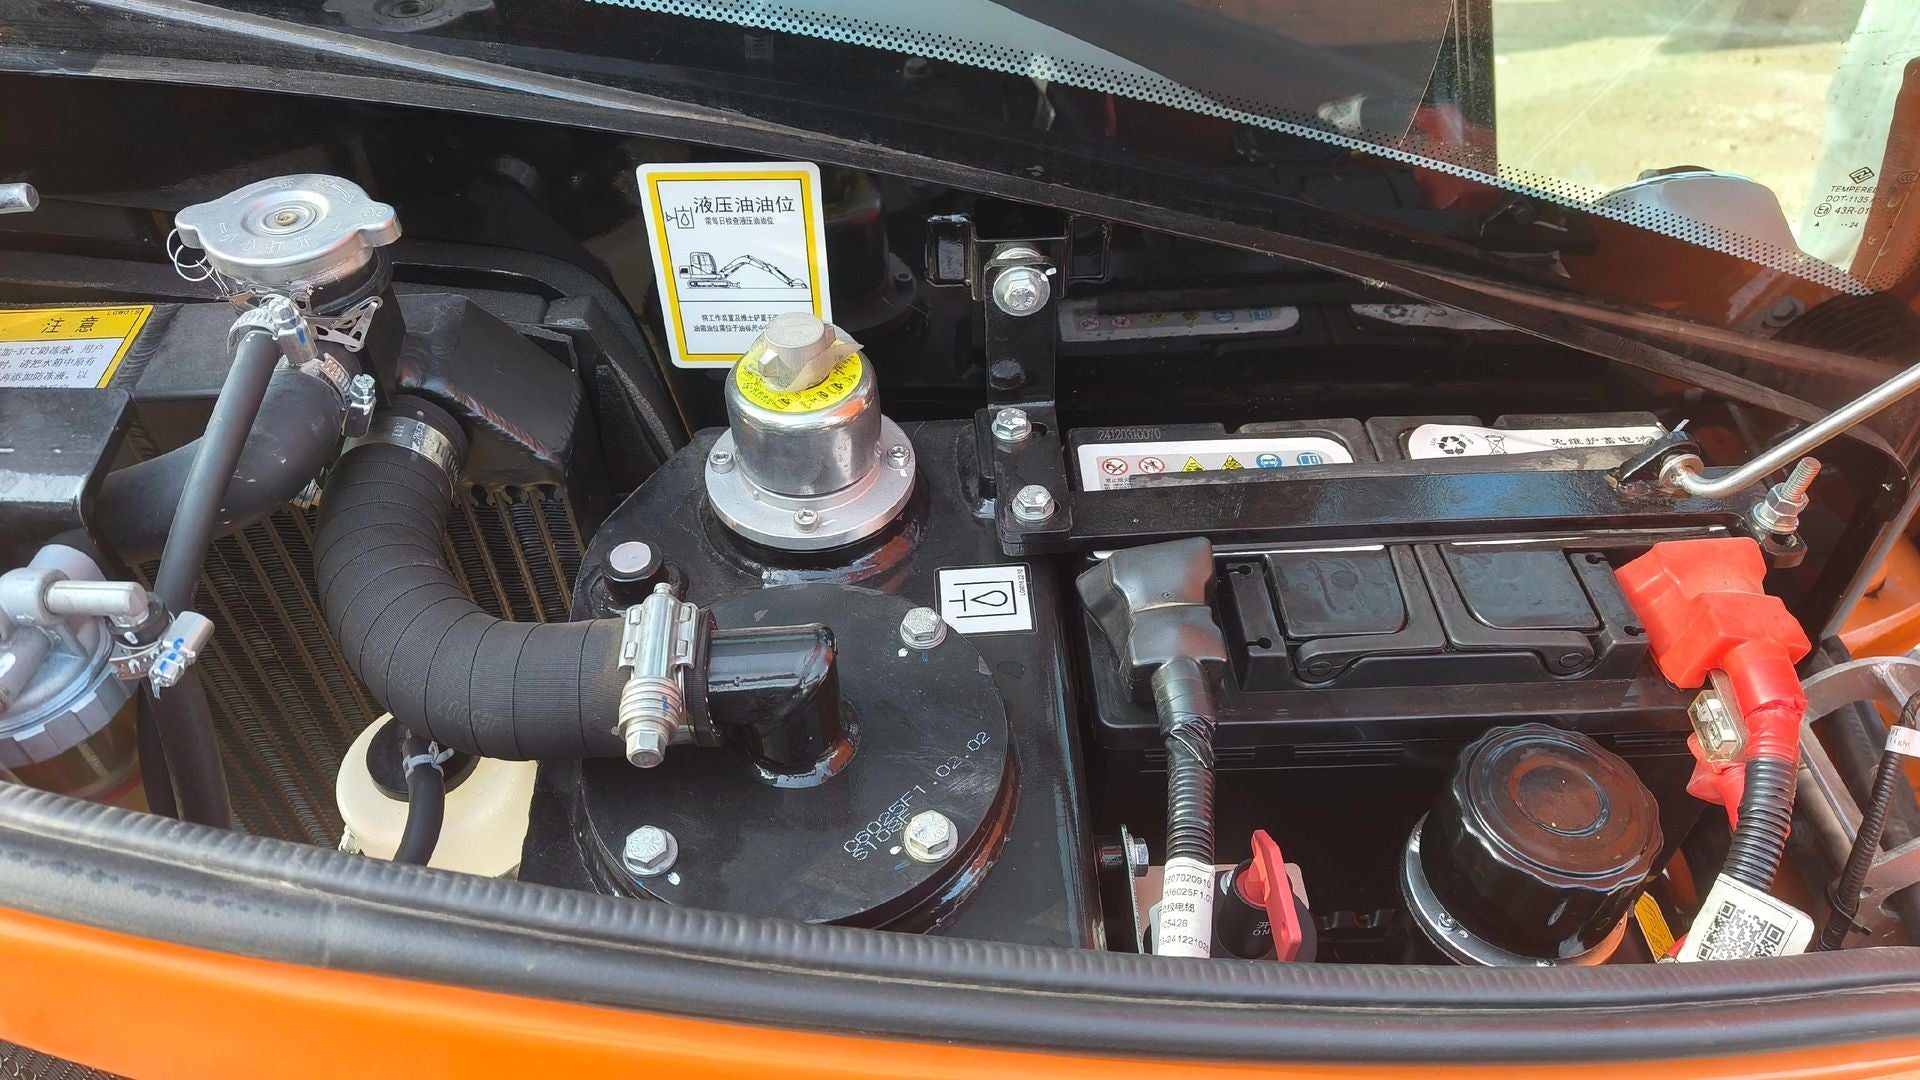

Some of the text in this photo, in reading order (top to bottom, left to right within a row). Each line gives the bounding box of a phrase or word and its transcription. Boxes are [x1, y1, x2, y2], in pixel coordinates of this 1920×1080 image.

[694, 196, 796, 213] 液压油油位
[705, 216, 774, 225] 需每日检查液压油油位
[41, 316, 100, 333] 注意
